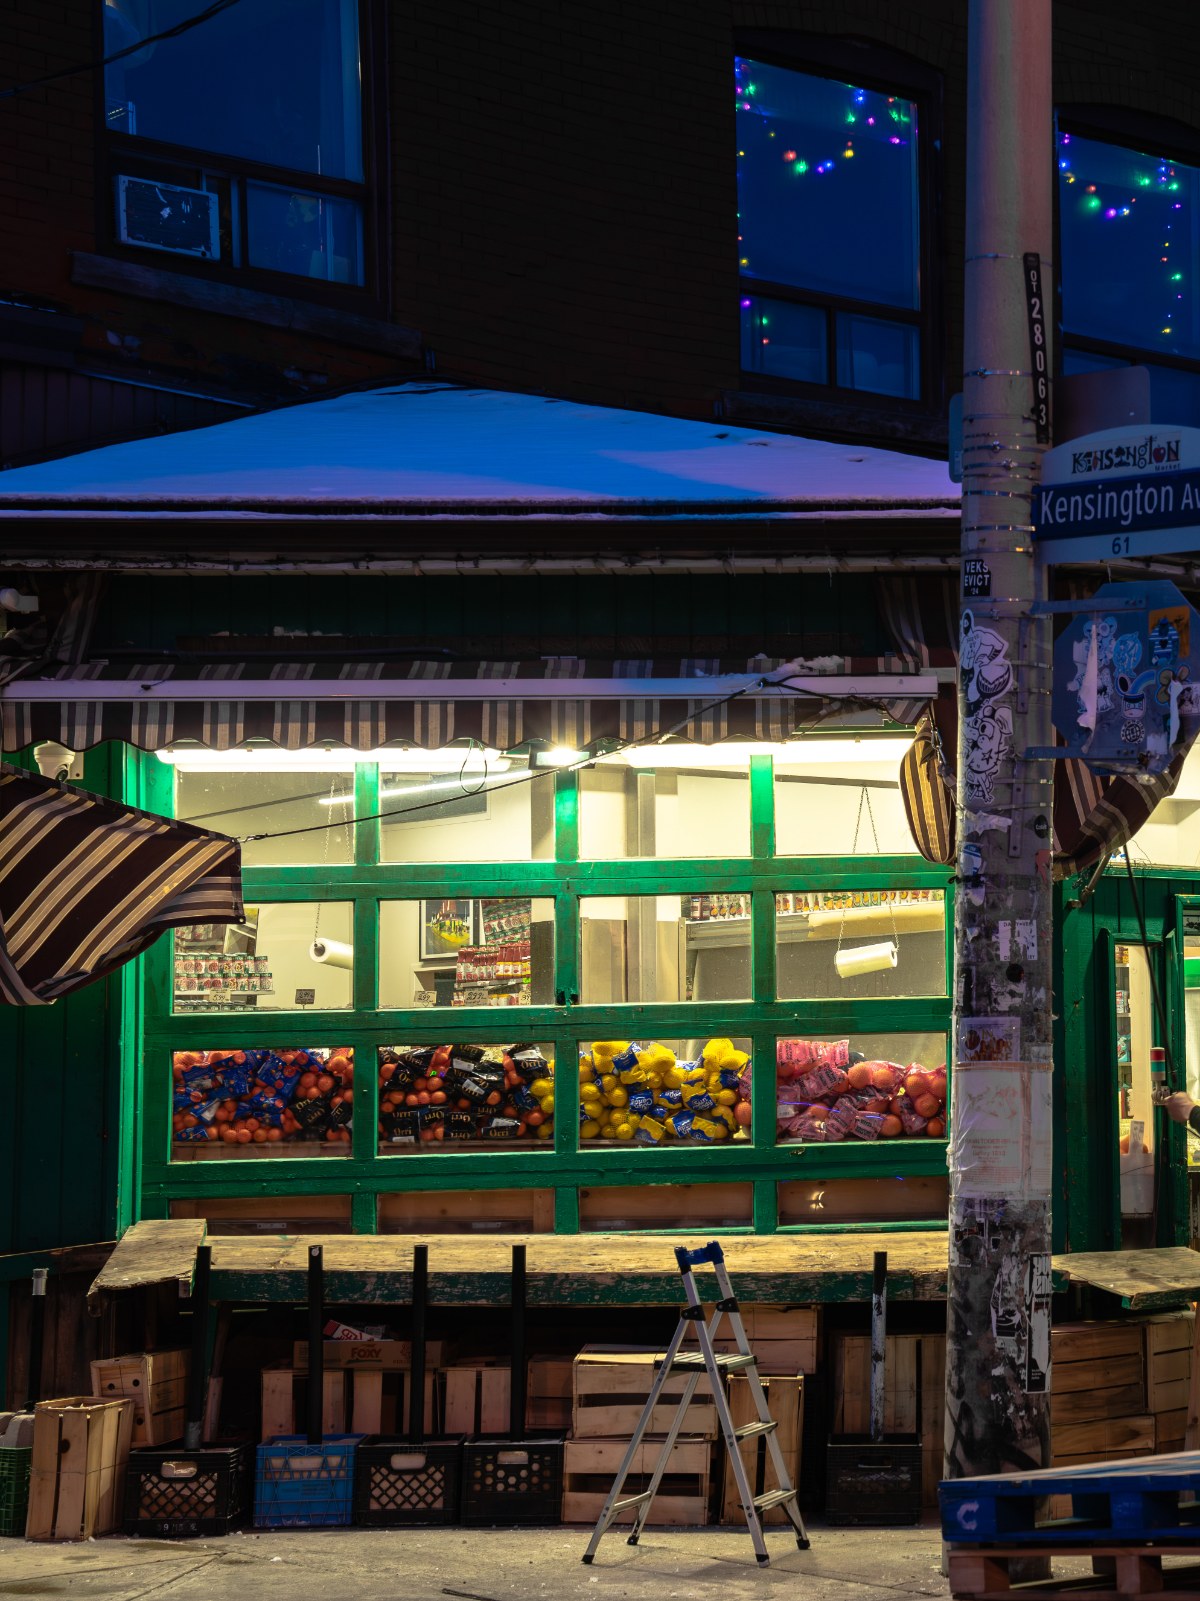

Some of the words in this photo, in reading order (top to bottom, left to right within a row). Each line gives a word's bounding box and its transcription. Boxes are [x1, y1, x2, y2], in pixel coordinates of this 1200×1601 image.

[1030, 297, 1047, 426] 28063
[1041, 482, 1174, 525] Kensington
[1112, 537, 1130, 554] 61
[964, 575, 990, 586] EVICT
[489, 1129, 509, 1137] Orri
[351, 1347, 383, 1359] FOXY
